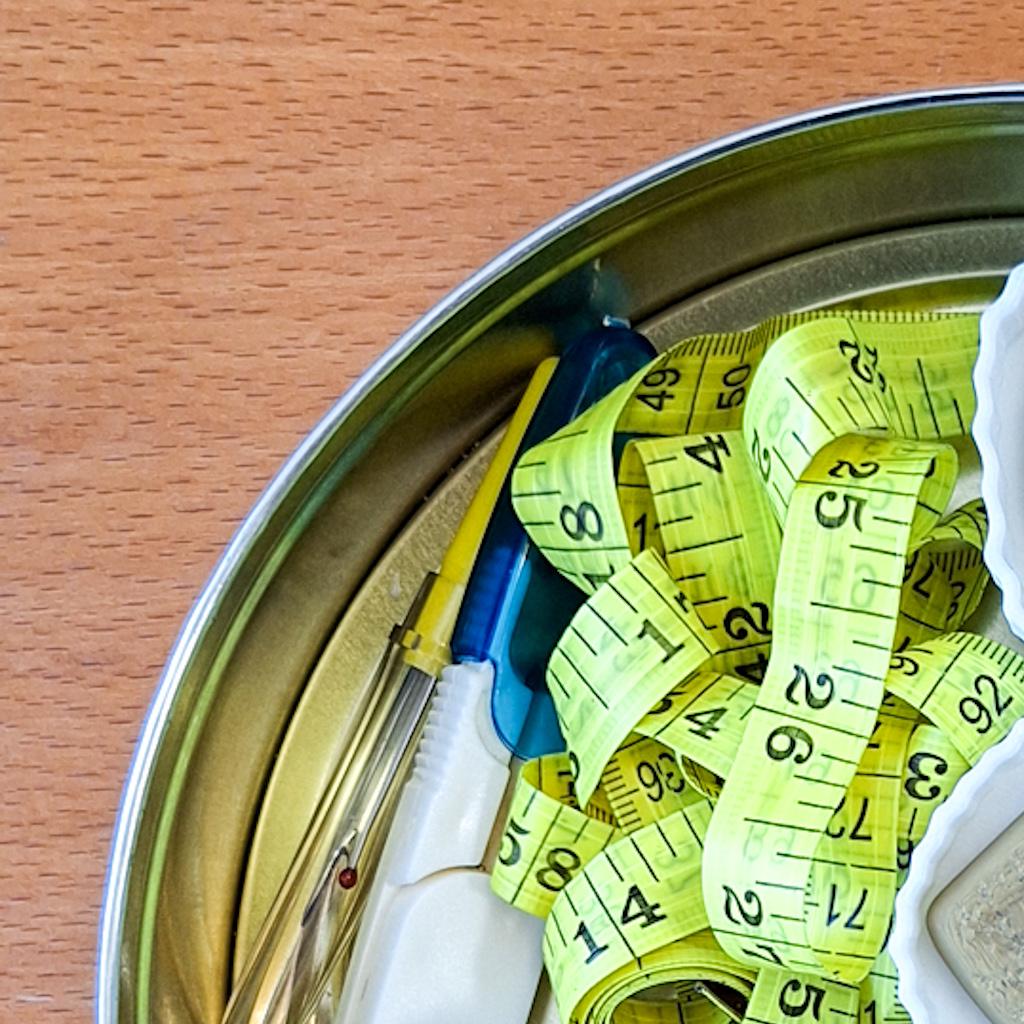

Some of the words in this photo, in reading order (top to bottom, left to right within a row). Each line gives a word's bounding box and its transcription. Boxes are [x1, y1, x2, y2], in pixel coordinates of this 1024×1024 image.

[635, 367, 681, 412] 49
[716, 364, 751, 410] 50
[684, 434, 731, 474] 4
[764, 664, 835, 765] 26
[958, 674, 1013, 734] 92
[903, 752, 948, 801] 3
[572, 884, 668, 965] 14
[826, 883, 869, 931] 71
